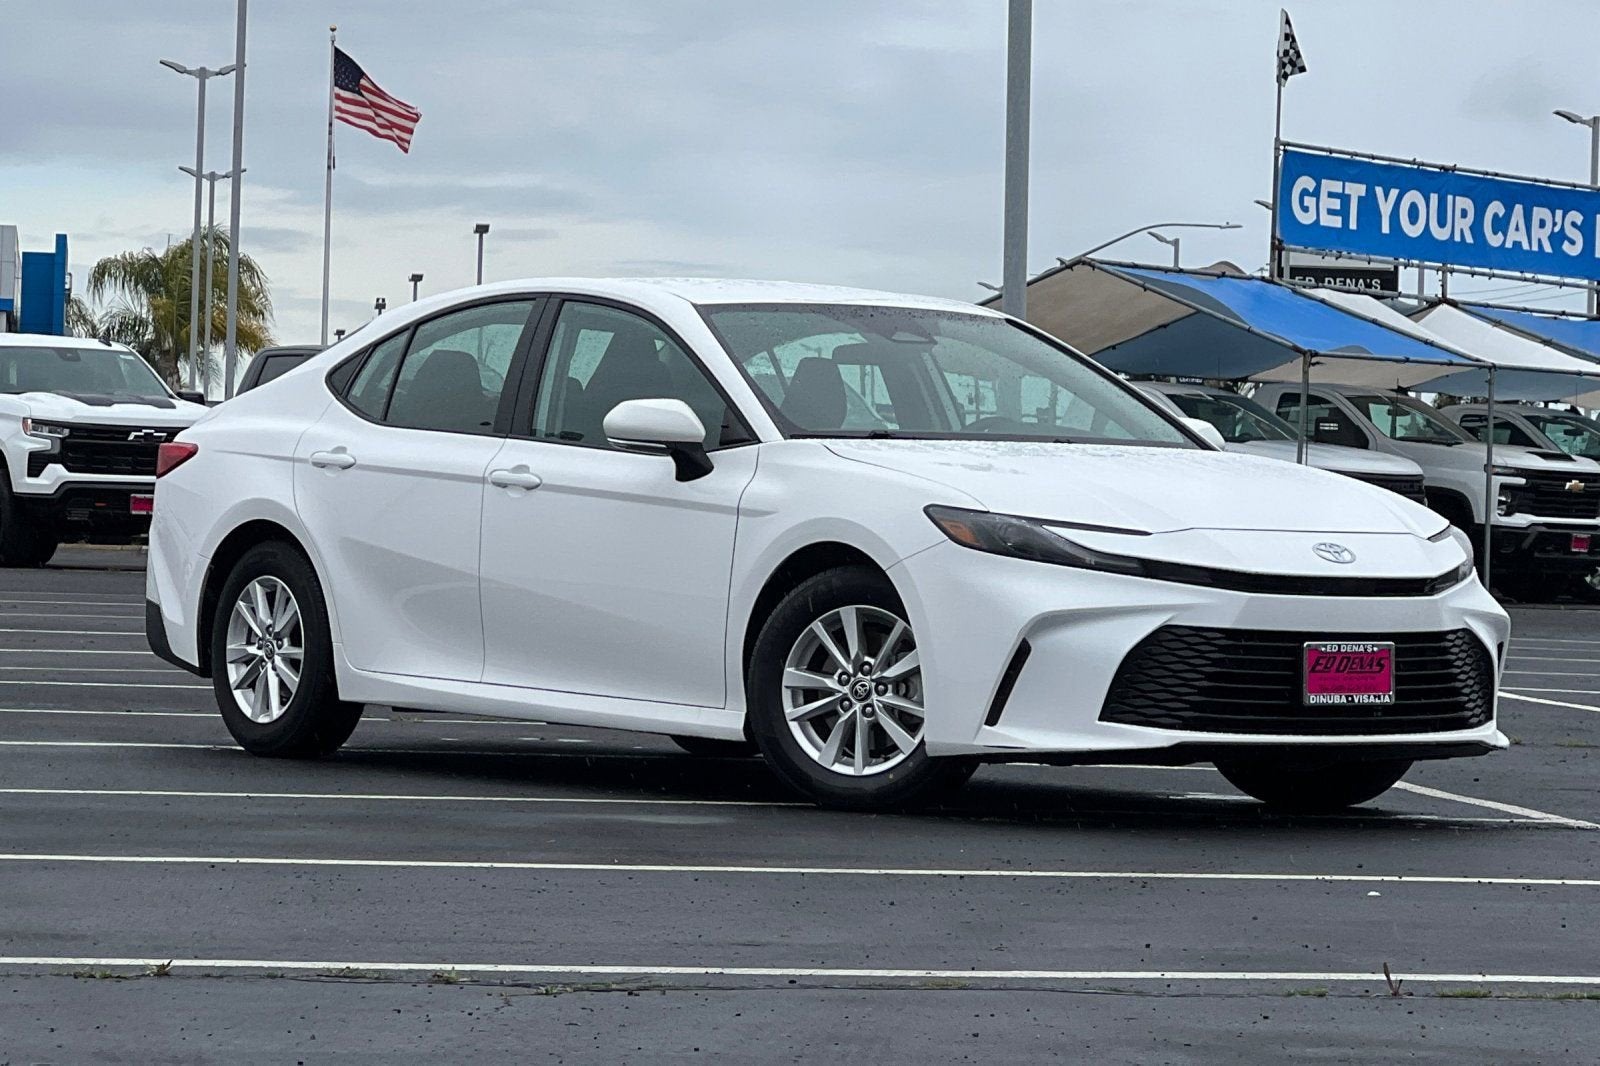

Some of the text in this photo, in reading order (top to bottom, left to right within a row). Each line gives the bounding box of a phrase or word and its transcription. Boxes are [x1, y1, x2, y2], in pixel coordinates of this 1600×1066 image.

[1291, 175, 1366, 231] GET
[1375, 186, 1474, 244] YOUR
[1483, 200, 1584, 257] CAR'S
[1324, 277, 1381, 290] DENA'S
[1326, 644, 1373, 652] ED DENA'S
[1309, 655, 1337, 673] ED
[1309, 694, 1391, 704] DINUBA VISALIA
